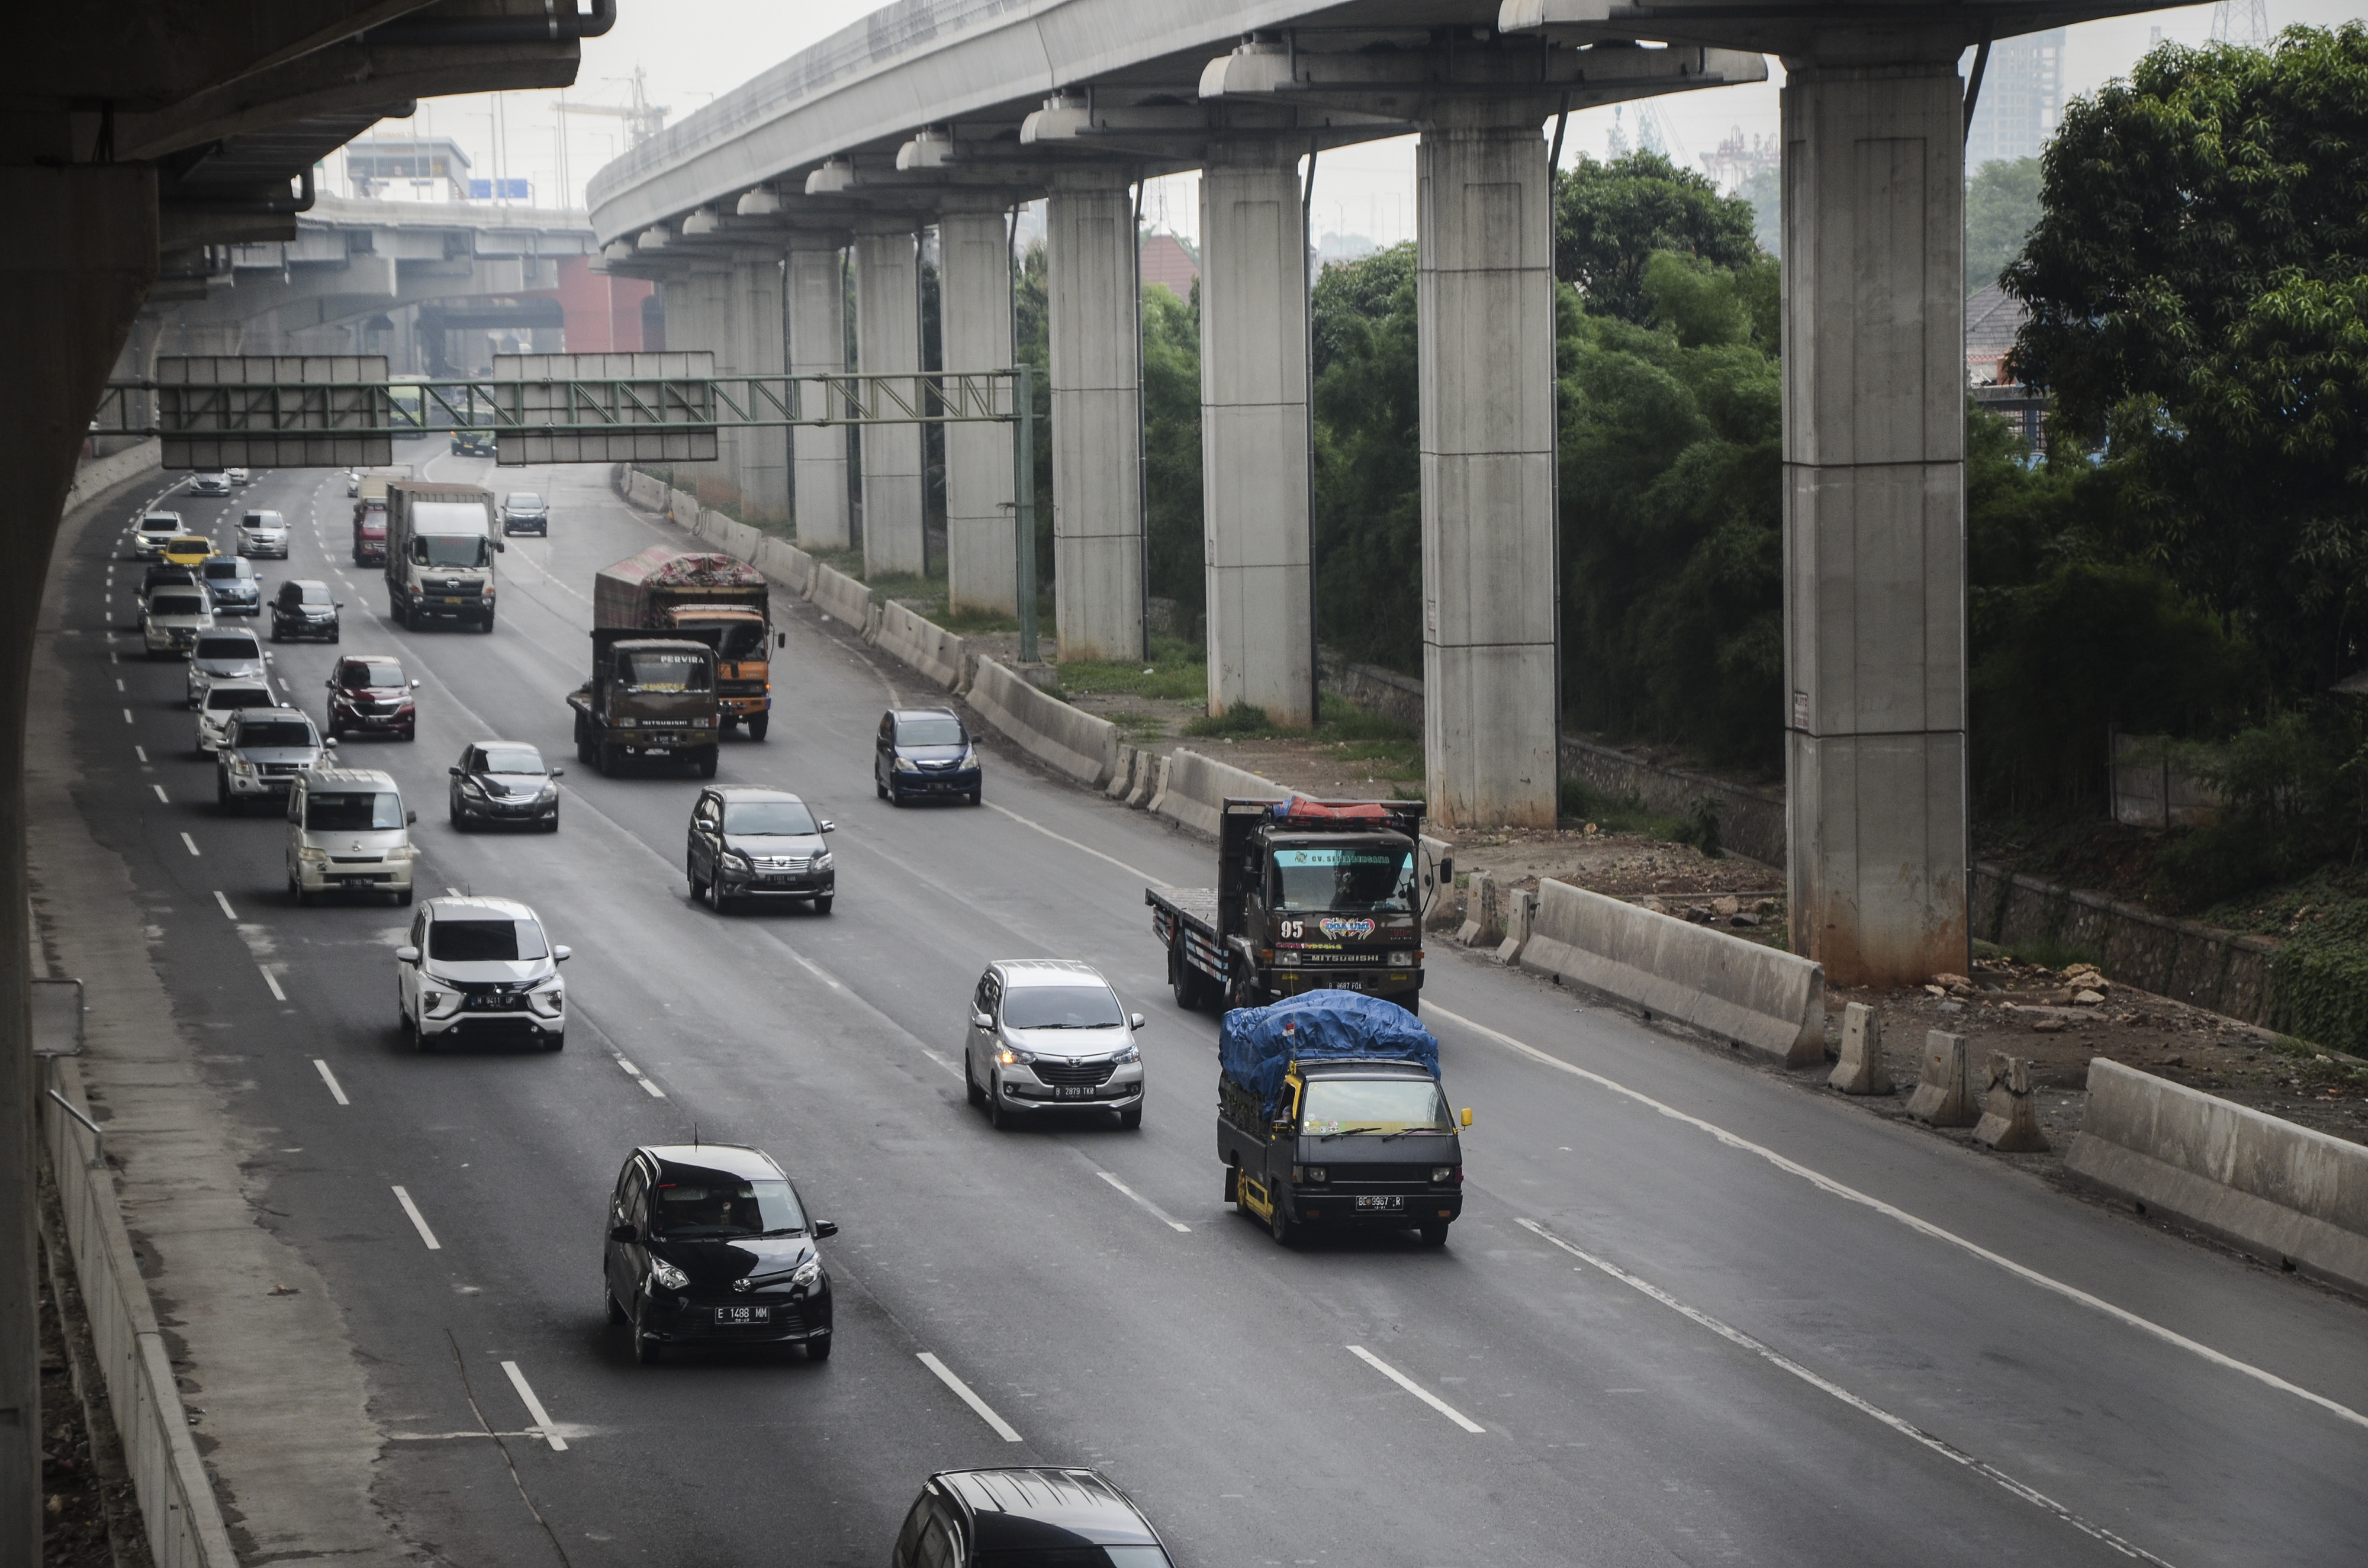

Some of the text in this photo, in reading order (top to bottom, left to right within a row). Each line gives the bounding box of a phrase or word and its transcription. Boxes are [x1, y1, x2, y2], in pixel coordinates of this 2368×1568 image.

[1281, 920, 1304, 938] 95
[1350, 922, 1370, 931] UMI
[718, 1308, 723, 1318] E
[730, 1308, 749, 1318] 1488
